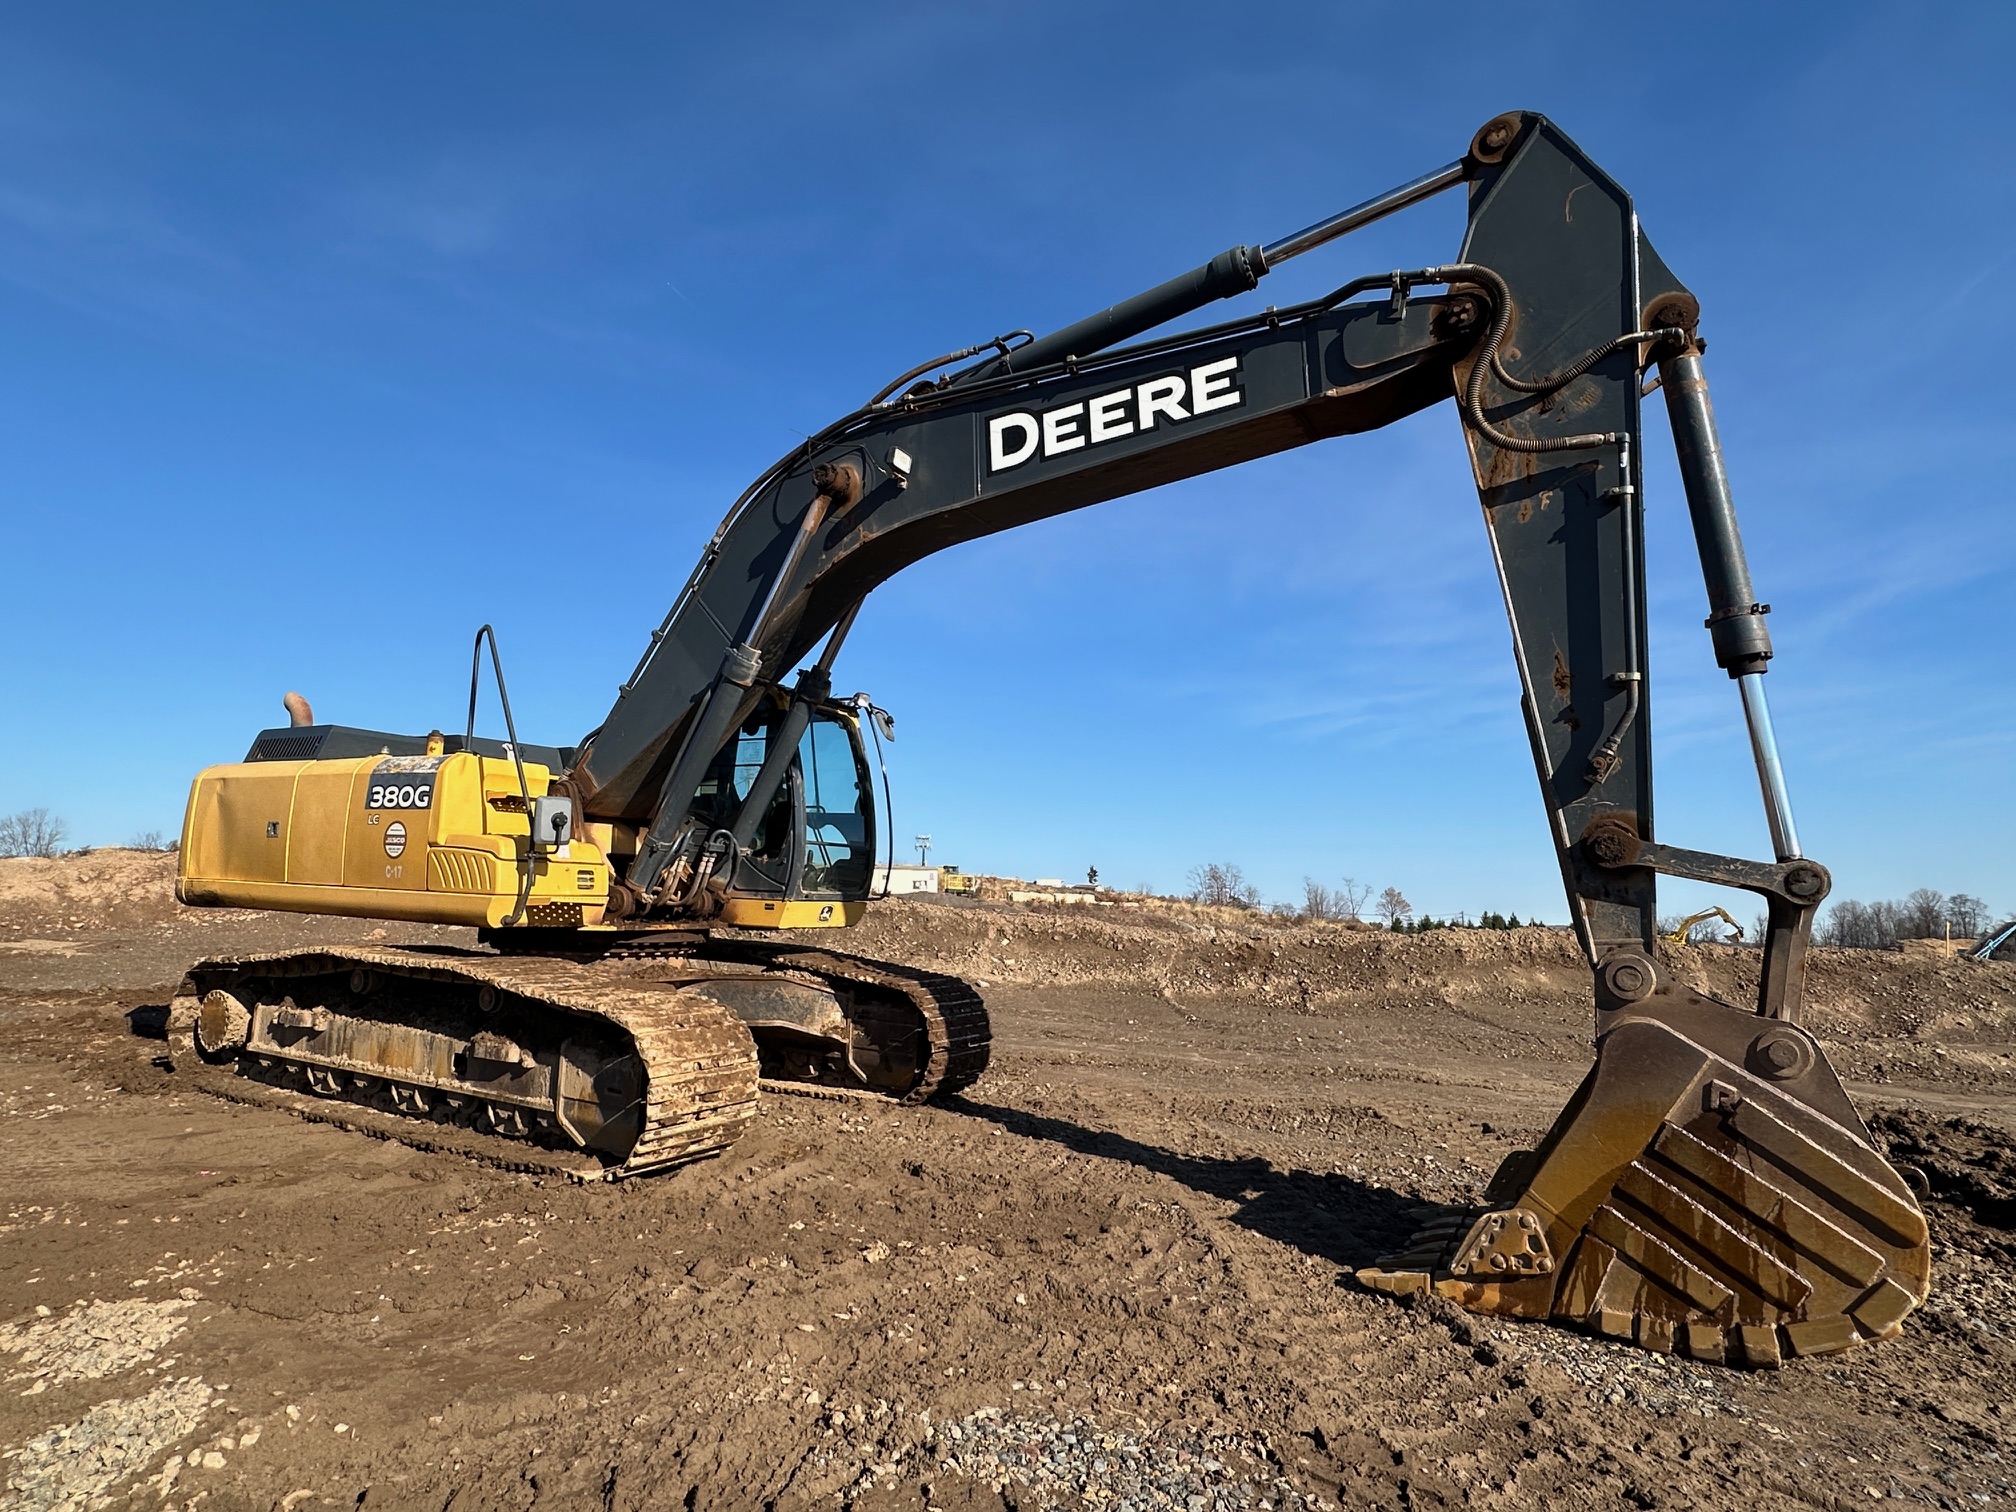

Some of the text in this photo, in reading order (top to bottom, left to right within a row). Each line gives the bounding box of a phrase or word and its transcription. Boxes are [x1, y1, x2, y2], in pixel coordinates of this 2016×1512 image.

[989, 356, 1241, 472] DEERE
[369, 785, 431, 809] 380G
[368, 814, 379, 825] LC
[385, 865, 402, 878] C-17
